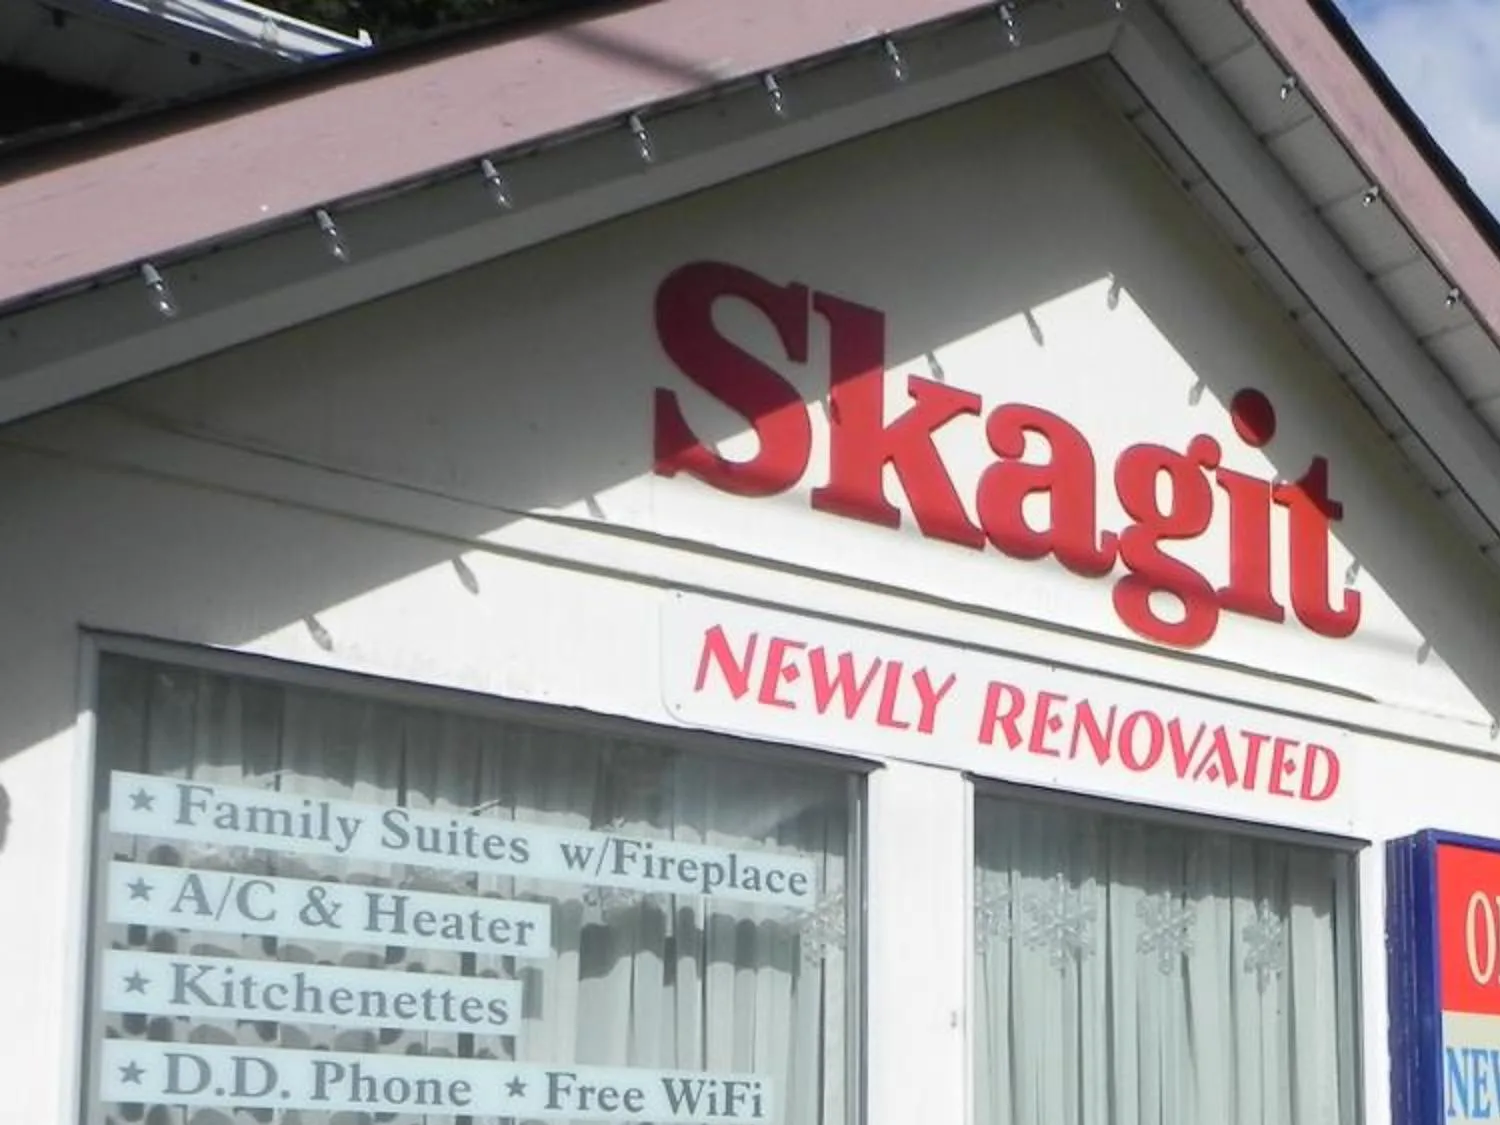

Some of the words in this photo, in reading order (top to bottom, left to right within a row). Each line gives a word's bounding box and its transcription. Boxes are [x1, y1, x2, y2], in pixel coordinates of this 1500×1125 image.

[653, 260, 1361, 650] Skagit
[694, 624, 957, 736] NEWLY
[978, 681, 1341, 803] RENOVATED
[174, 782, 361, 854] Family
[381, 807, 530, 864] Suites
[561, 837, 808, 896] w/Fireplace
[171, 873, 276, 922] A/C
[299, 885, 341, 929] &
[364, 892, 535, 946] Heater
[169, 962, 509, 1026] Kitchenettes
[162, 1052, 290, 1099] D.D.
[310, 1059, 472, 1107] Phone
[546, 1071, 644, 1114] Free
[661, 1078, 764, 1118] WiFi
